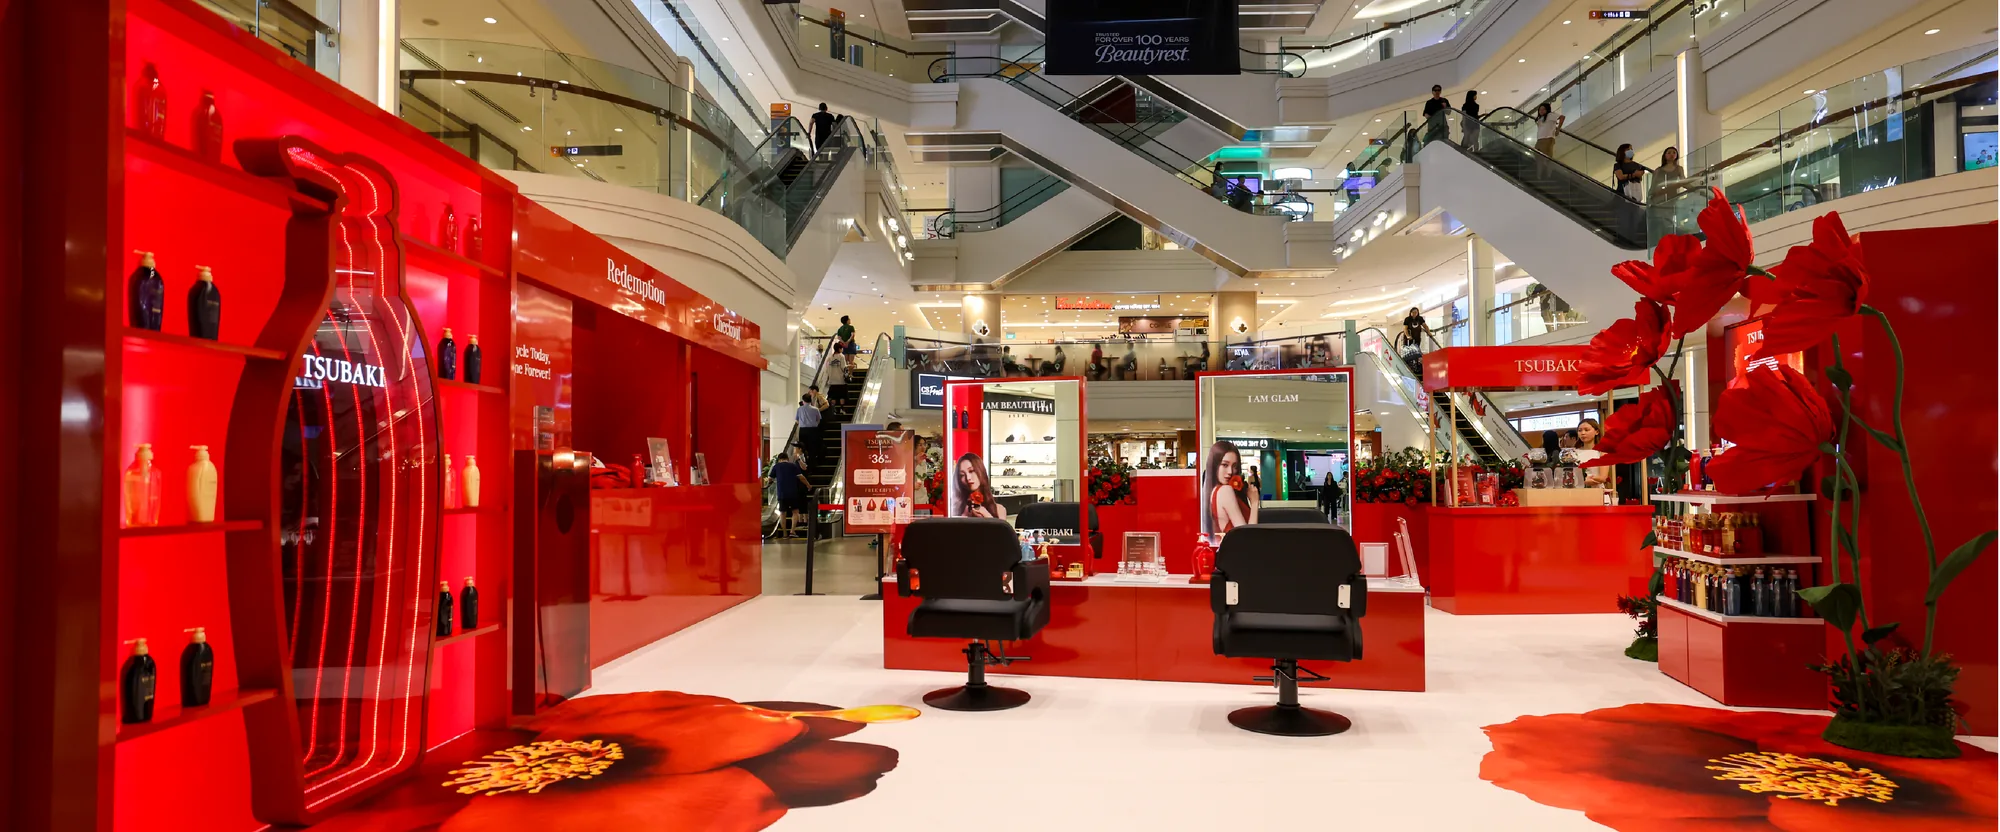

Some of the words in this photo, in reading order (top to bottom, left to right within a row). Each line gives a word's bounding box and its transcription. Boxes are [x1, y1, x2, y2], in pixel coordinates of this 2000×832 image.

[1135, 34, 1162, 45] 100
[1095, 43, 1190, 65] Beautyrest
[606, 257, 666, 307] Redemption
[530, 347, 551, 365] Today,
[303, 354, 385, 388] TSUBAKI
[524, 363, 551, 380] Forever!
[986, 402, 999, 410] AM
[1248, 395, 1252, 403] I
[1253, 394, 1269, 403] AM
[1271, 394, 1299, 402] GLAM
